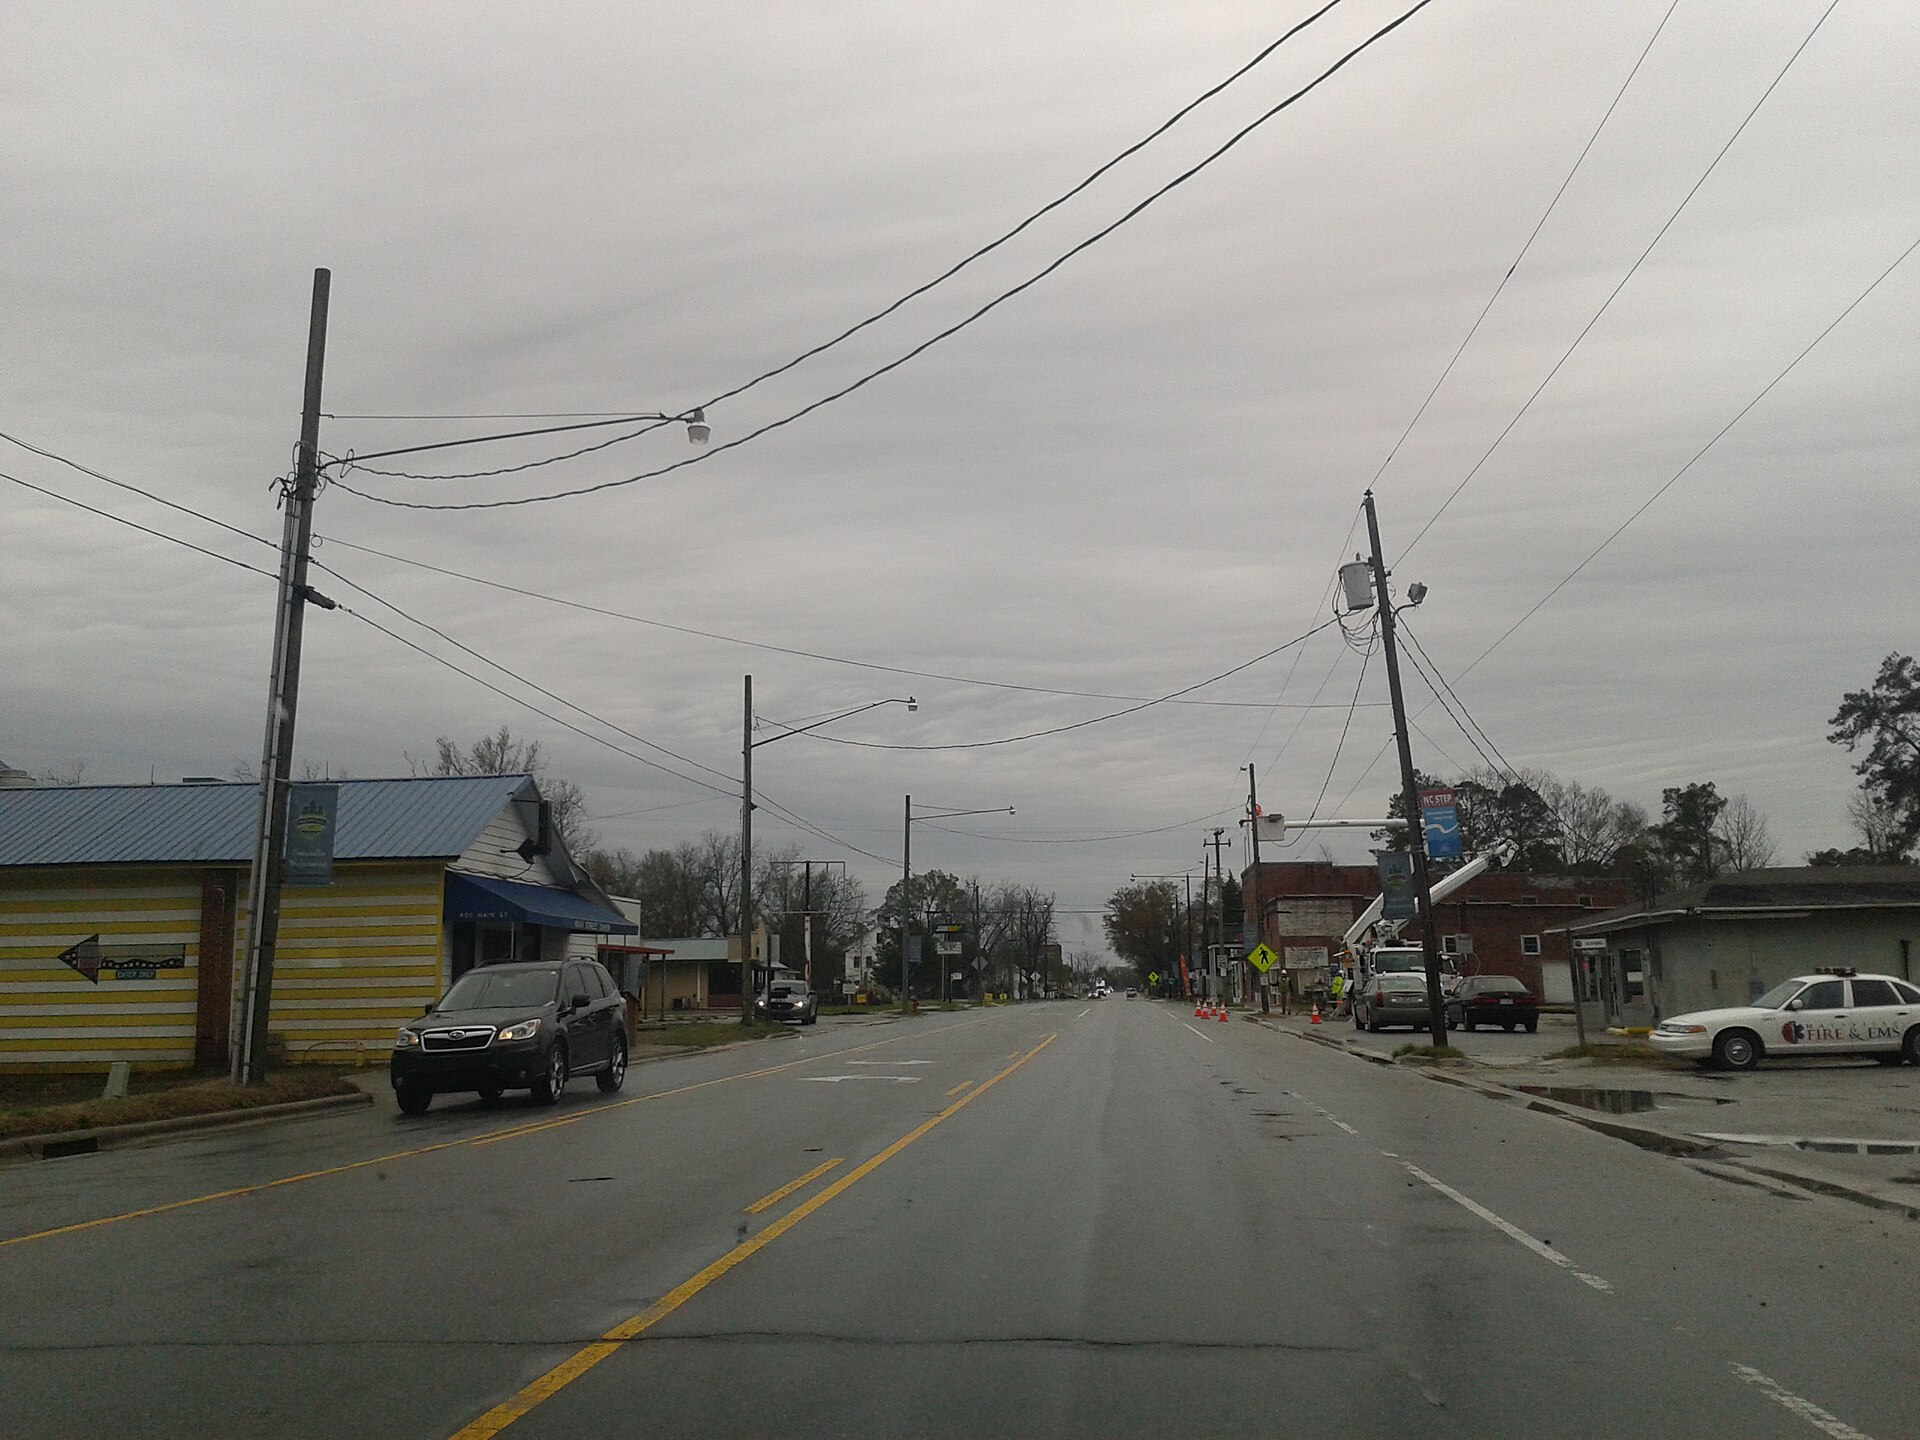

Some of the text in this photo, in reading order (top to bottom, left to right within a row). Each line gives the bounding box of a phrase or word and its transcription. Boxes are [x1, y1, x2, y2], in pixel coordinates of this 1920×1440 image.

[1423, 794, 1452, 805] NC STEP
[1807, 1026, 1900, 1041] FIRE & EMS
